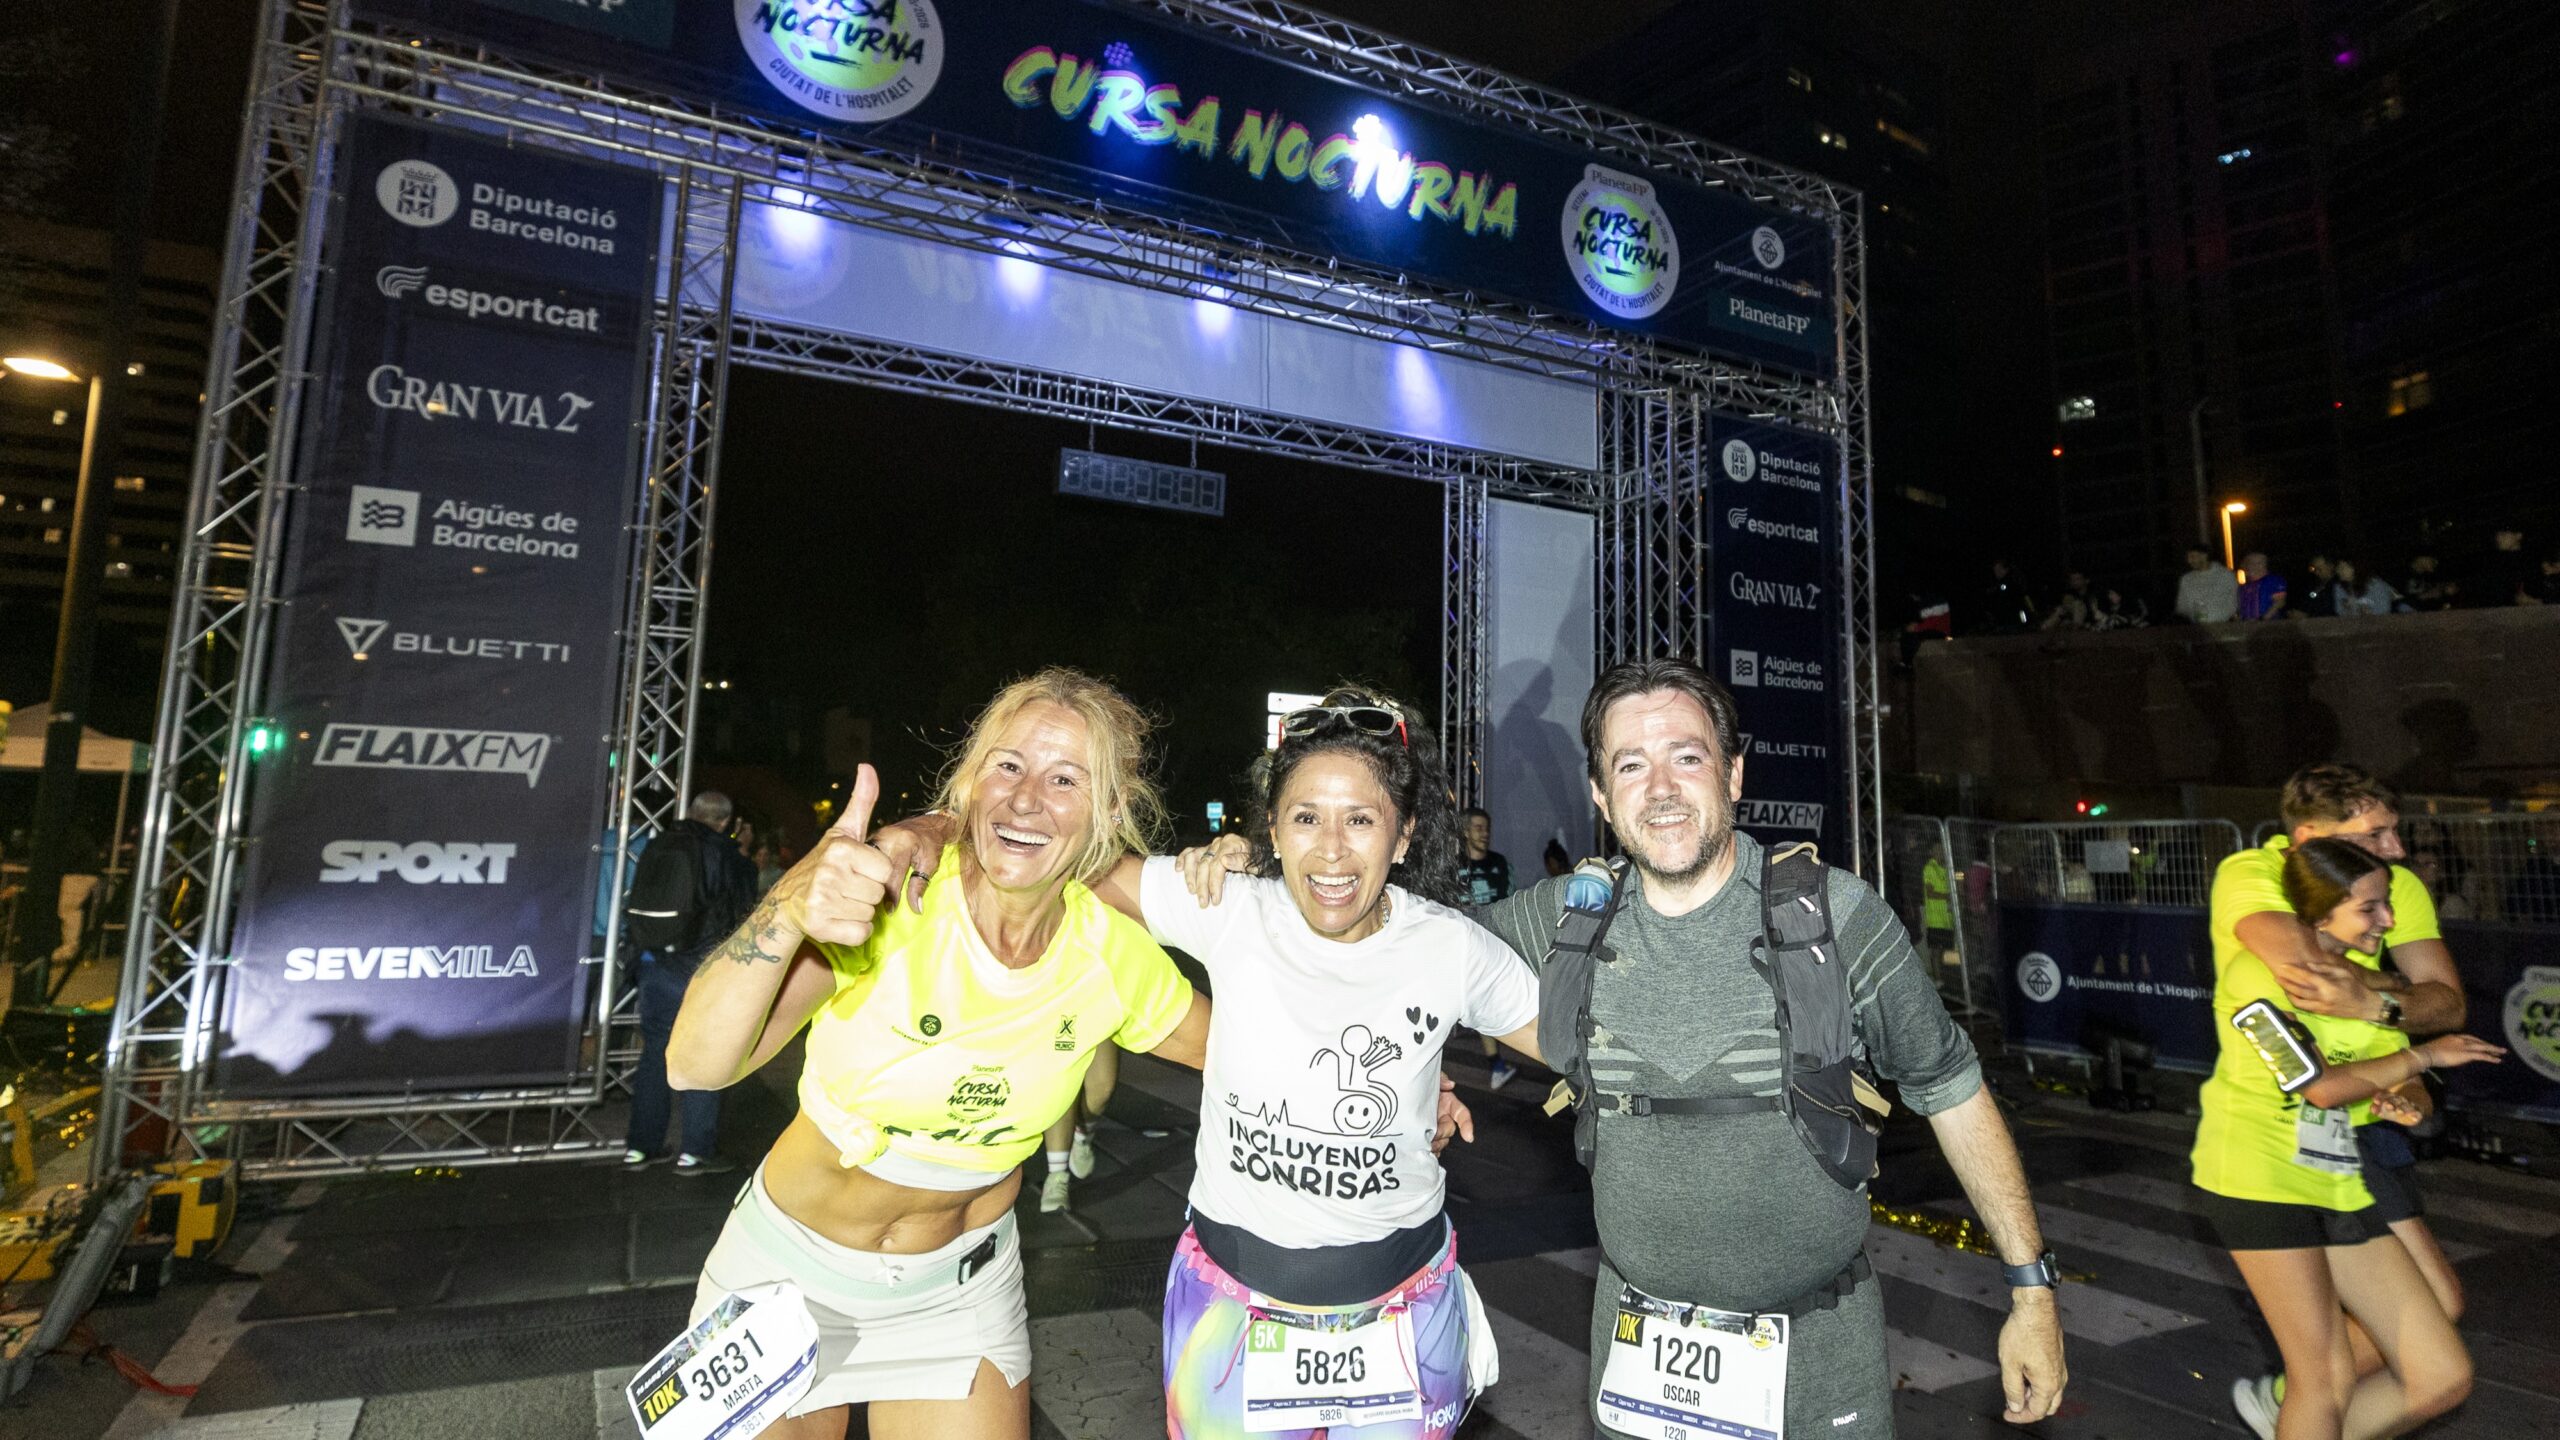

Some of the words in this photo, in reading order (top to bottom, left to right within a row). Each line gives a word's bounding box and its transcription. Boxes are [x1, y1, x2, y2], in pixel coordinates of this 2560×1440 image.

[754, 2, 925, 64] NOCTURNA
[769, 58, 813, 95] CIUTAT
[814, 90, 830, 104] DE
[835, 76, 914, 109] L'HOSPITALET
[1003, 45, 1220, 160] CURSA
[1227, 108, 1518, 239] NOCTURNA
[1591, 170, 1649, 197] PlanetaFP
[472, 182, 618, 229] Diputació
[469, 208, 615, 254] Barcelona
[1583, 206, 1652, 243] CURSA
[1573, 230, 1669, 271] NOCTURNA
[1584, 273, 1609, 301] CIUTAT
[1610, 294, 1620, 307] DE
[1621, 282, 1665, 309] L'HOSPITALET
[1714, 260, 1762, 283] Ajuntament
[1763, 274, 1774, 286] de
[1775, 277, 1822, 299] L'Hospitalet
[425, 283, 601, 332] esportcat
[1730, 297, 1809, 335] PlanetaFP
[367, 364, 481, 421] GRAN
[487, 388, 549, 431] VIA
[554, 391, 595, 433] 2
[1760, 451, 1820, 476] Diputació
[1760, 468, 1821, 492] Barcelona
[432, 499, 535, 531] Aigües
[541, 512, 578, 534] de
[1747, 518, 1819, 544] esportcat
[432, 525, 579, 559] Barcelona
[1730, 571, 1776, 606] GRAN
[1778, 583, 1804, 609] VIA
[1806, 583, 1821, 610] 2
[392, 631, 571, 663] BLUETTI
[1764, 655, 1804, 675] Aigües
[1807, 661, 1822, 676] de
[1764, 672, 1824, 692] Barcelona
[1755, 740, 1826, 759] BLUETTI
[319, 840, 518, 885] SPORT
[2067, 975, 2135, 994] Ajuntament
[2138, 982, 2153, 994] de
[946, 1094, 1008, 1108] NOCTURNA
[957, 1081, 1001, 1096] CURSA
[1229, 1116, 1397, 1171] INCLUYENDO
[1229, 1144, 1401, 1200] SONRISAS
[1254, 1323, 1279, 1349] 5K
[1618, 1312, 1641, 1342] 10K
[692, 1328, 764, 1402] 3631
[1296, 1346, 1366, 1385] 5826
[1652, 1334, 1722, 1385] 1220
[643, 1377, 682, 1422] 10K
[722, 1373, 763, 1411] MARTA
[1663, 1383, 1701, 1408] OSCAR
[741, 1411, 766, 1435] 3631
[1319, 1408, 1342, 1421] 5826
[1424, 1400, 1457, 1433] HOKA
[1664, 1424, 1687, 1440] 1220
